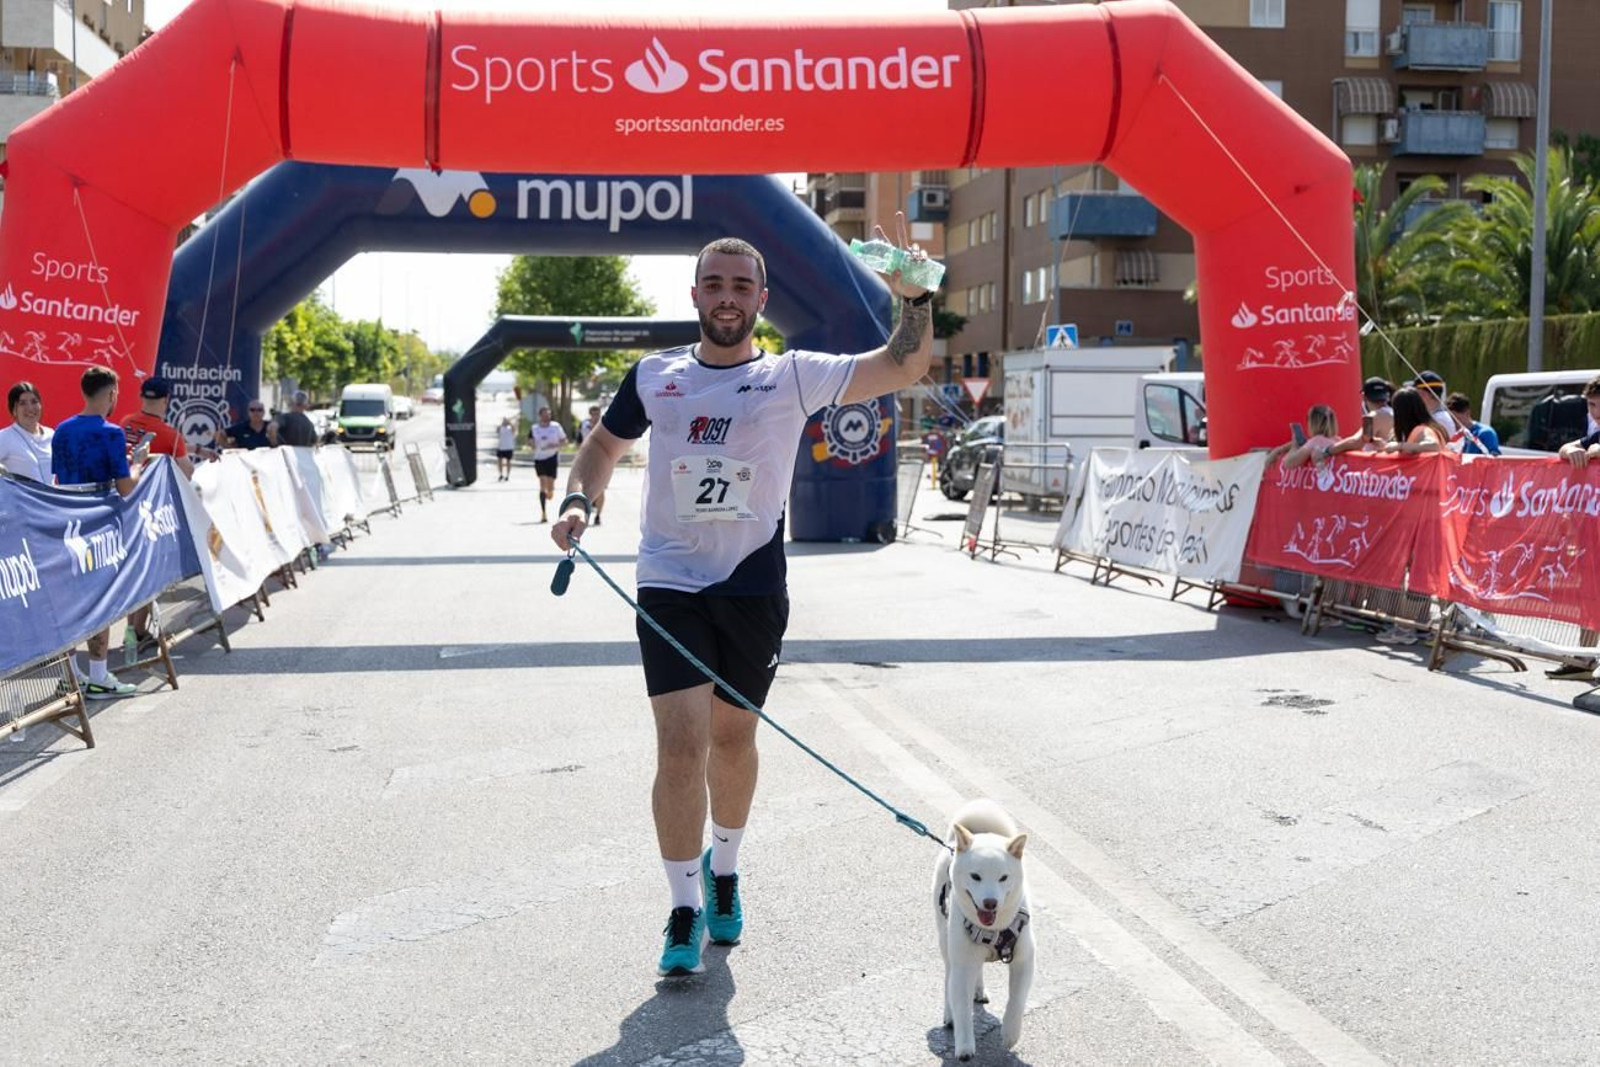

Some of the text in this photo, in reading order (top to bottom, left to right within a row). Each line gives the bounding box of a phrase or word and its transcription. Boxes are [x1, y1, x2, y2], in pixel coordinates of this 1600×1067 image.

[450, 44, 960, 104] Sports Santander
[615, 114, 785, 135] sportssantander.es
[517, 174, 692, 233] mupol
[32, 251, 109, 284] Sports
[1265, 266, 1333, 293] Sports
[20, 291, 140, 327] Santander
[161, 362, 242, 381] fundación
[173, 381, 227, 399] mupol
[695, 477, 731, 504] 27
[1276, 457, 1416, 500] Sports Santander
